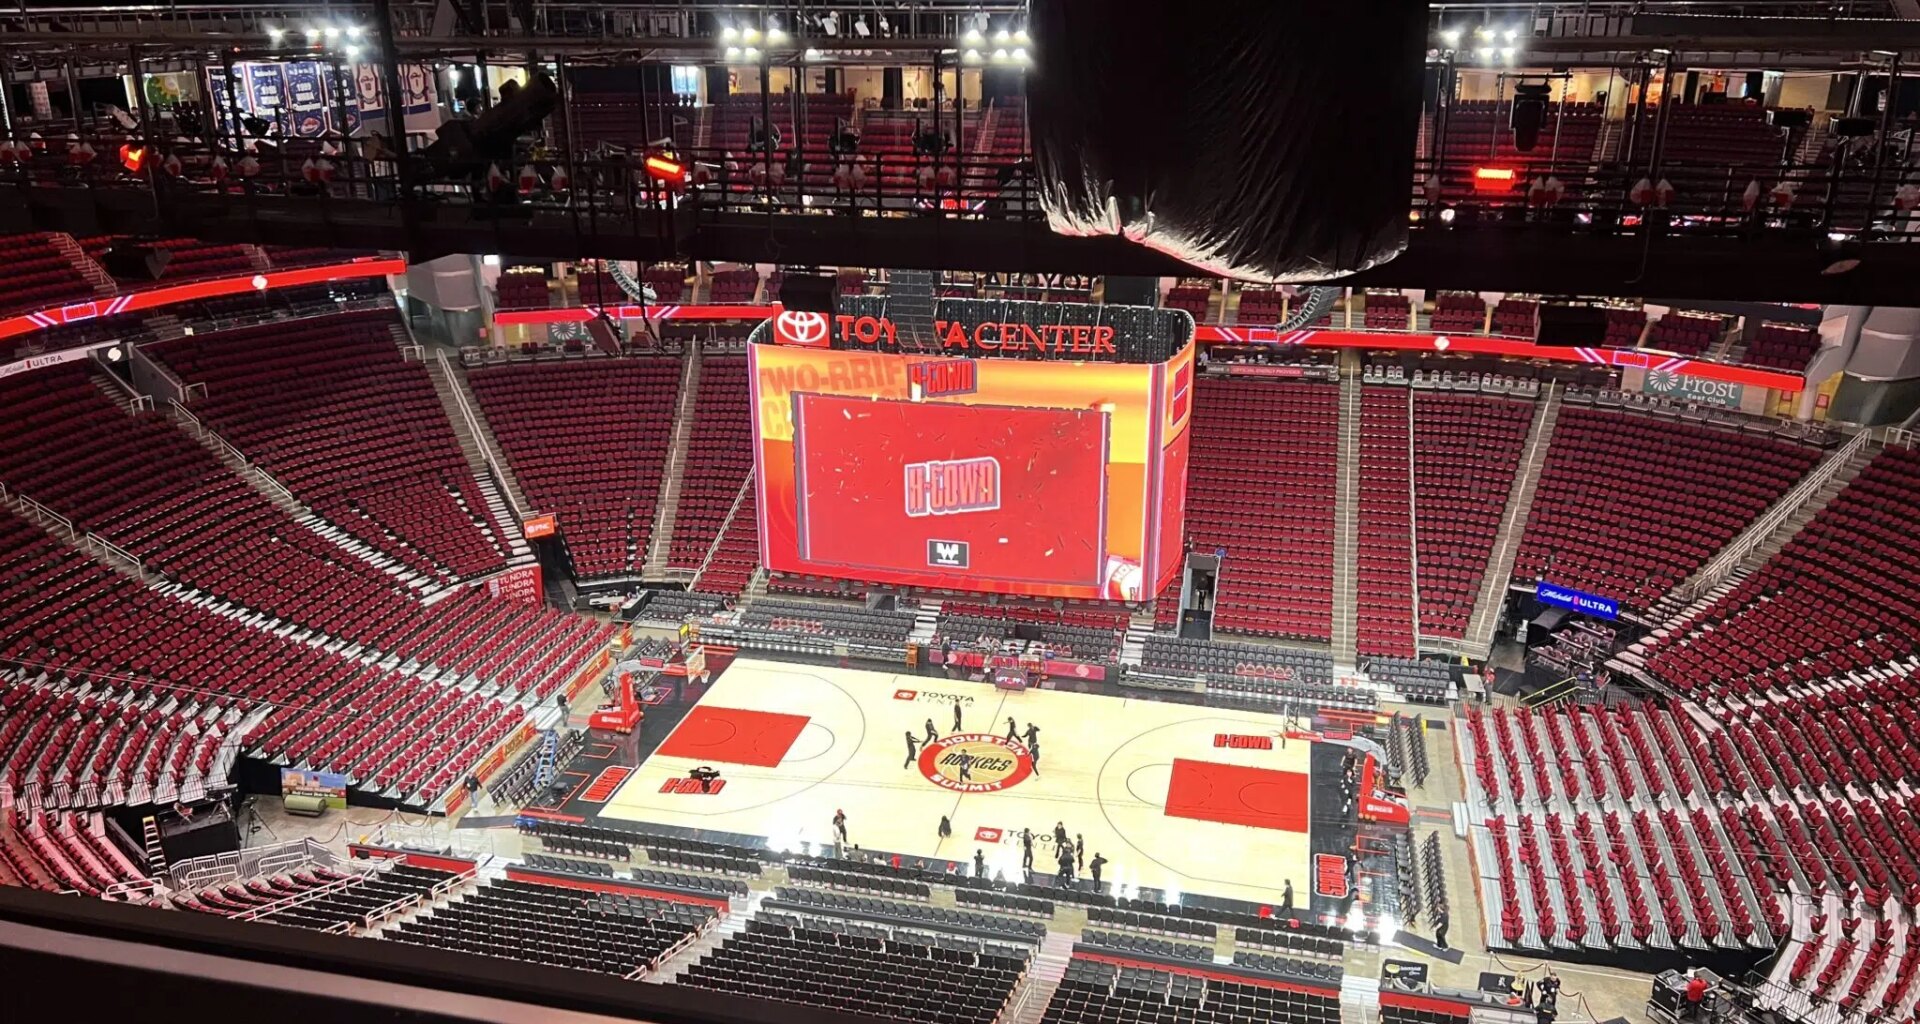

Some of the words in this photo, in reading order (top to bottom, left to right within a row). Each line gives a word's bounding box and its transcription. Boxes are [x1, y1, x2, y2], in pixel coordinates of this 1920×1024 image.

[835, 315, 969, 350] TOYA
[974, 321, 1116, 354] CENTER
[32, 355, 63, 367] ULTRA
[1681, 375, 1738, 399] Frost
[1707, 395, 1726, 405] Club
[500, 569, 535, 584] TUNDRA
[500, 578, 535, 594] TUNDRA
[504, 587, 536, 602] NDRA
[1579, 598, 1613, 614] ULTRA
[921, 691, 975, 703] TOYOTA
[939, 735, 1026, 757] HOUSTON
[658, 777, 727, 795] H-TON
[930, 773, 1003, 792] SUMMIT
[1007, 829, 1058, 842] TOYO
